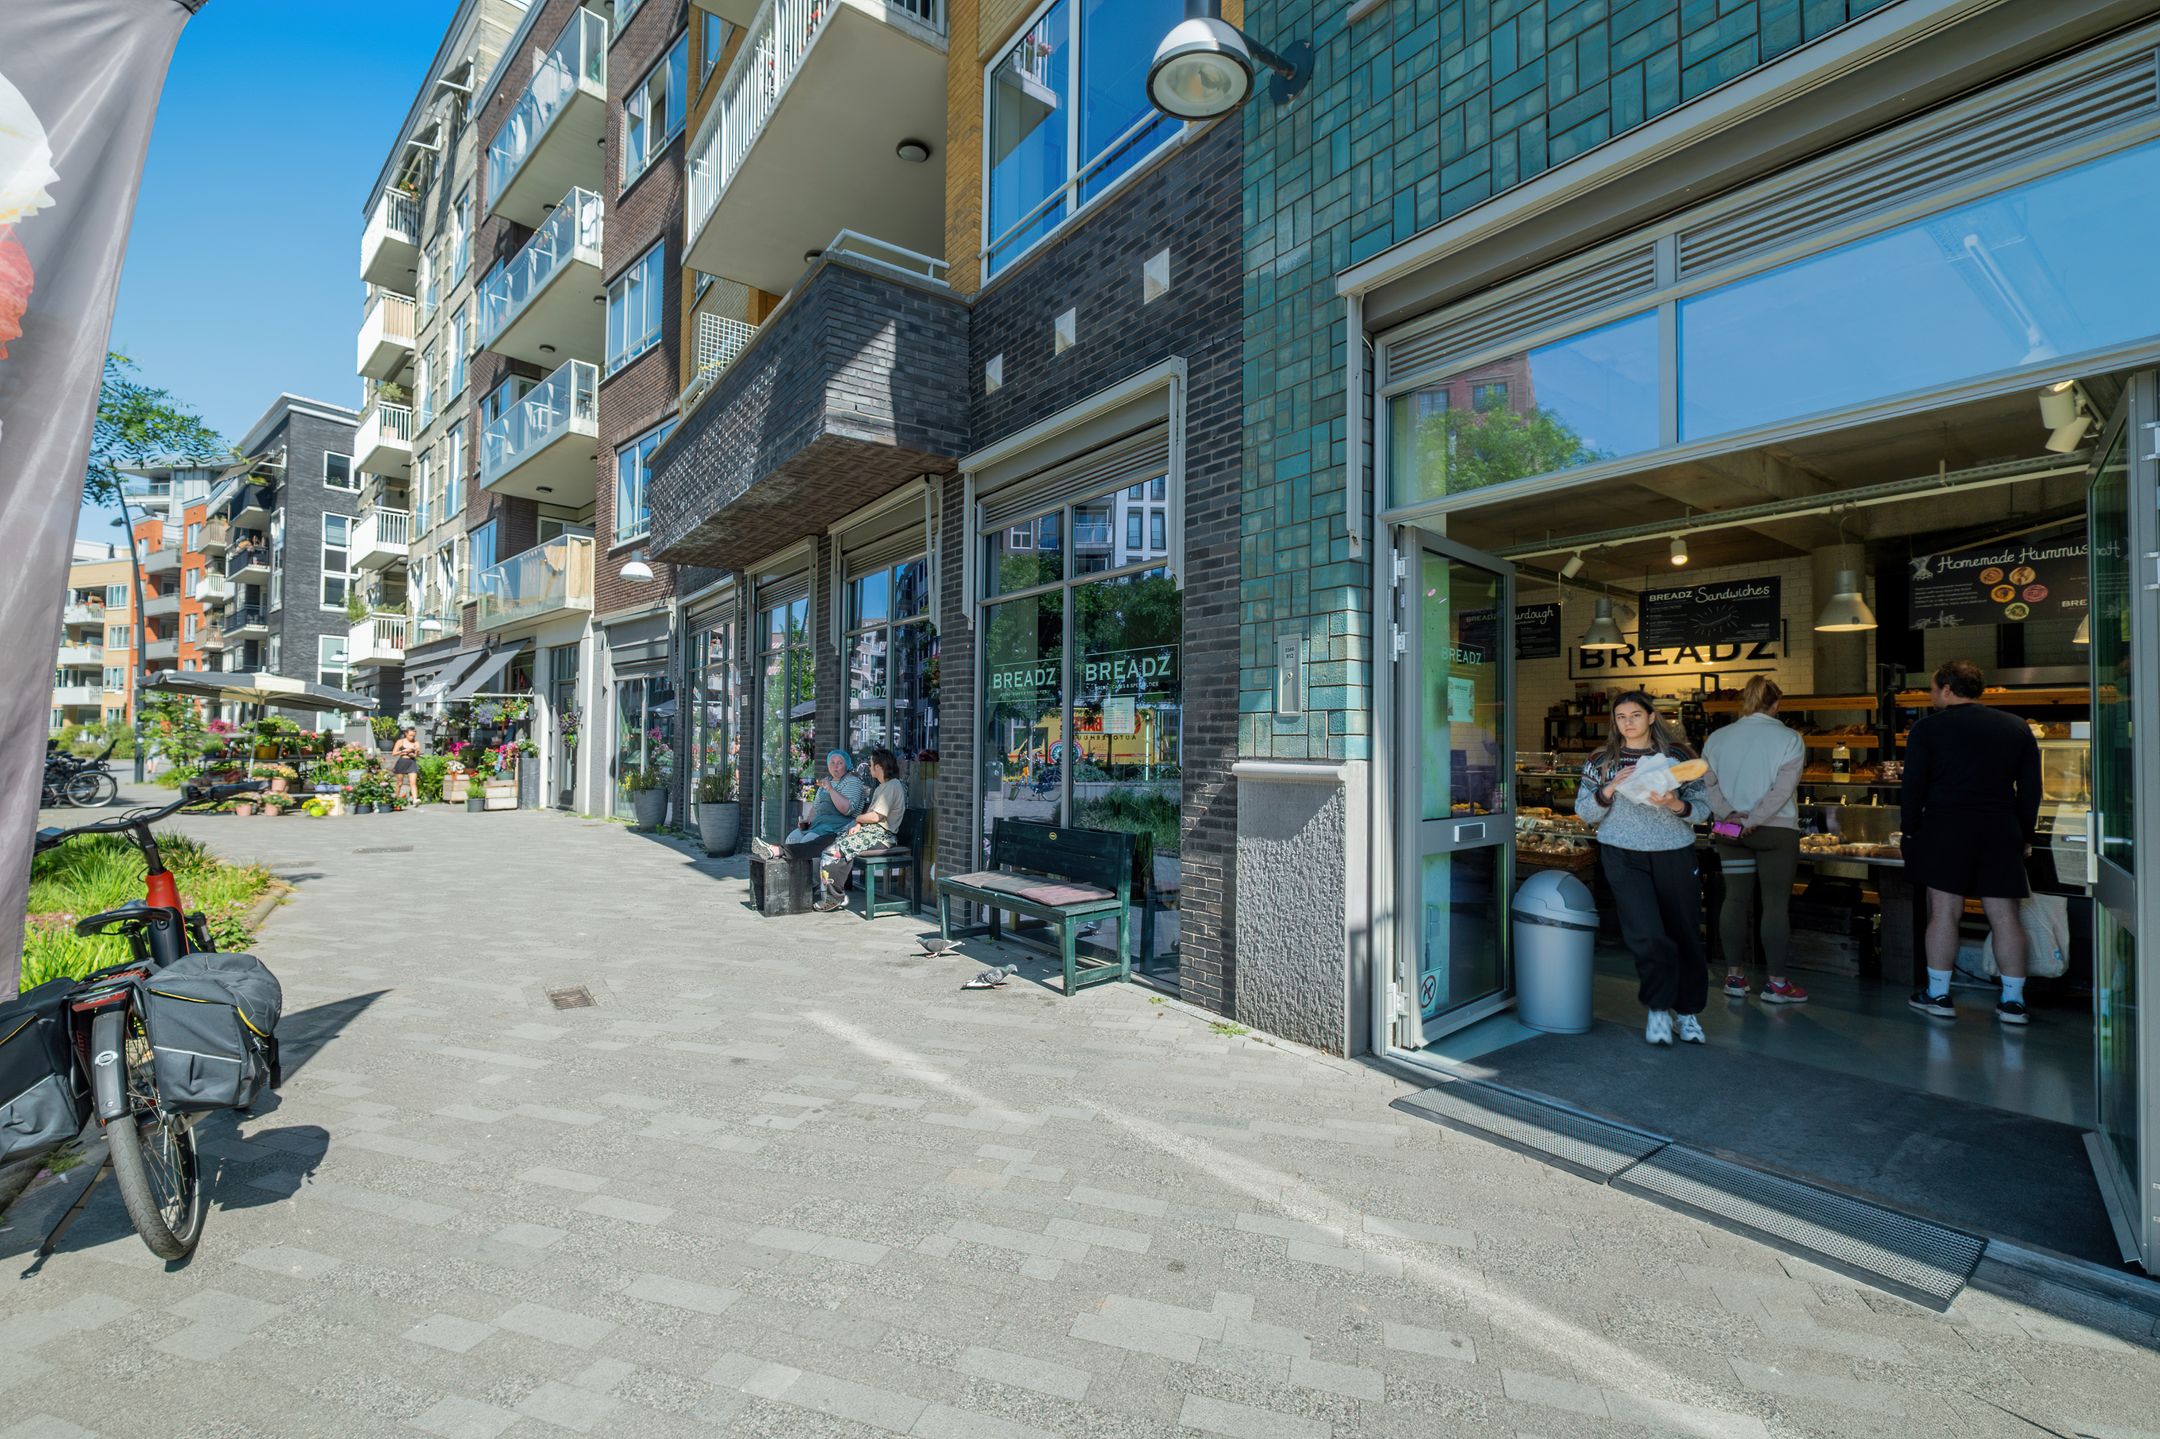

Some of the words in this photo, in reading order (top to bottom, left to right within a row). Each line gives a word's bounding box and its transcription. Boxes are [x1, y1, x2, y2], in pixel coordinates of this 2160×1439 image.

[1937, 549, 2015, 573] Homemade
[2018, 544, 2089, 564] Hummus
[1648, 590, 1693, 602] BREADZ
[1695, 583, 1770, 603] Sandwiches
[2061, 598, 2089, 608] BRE
[1514, 605, 1554, 625] urdough
[1441, 646, 1481, 665] BREADZ
[1580, 642, 1776, 669] BREADZ
[993, 668, 1056, 689] BREADZ
[1086, 655, 1171, 682] BREADZ
